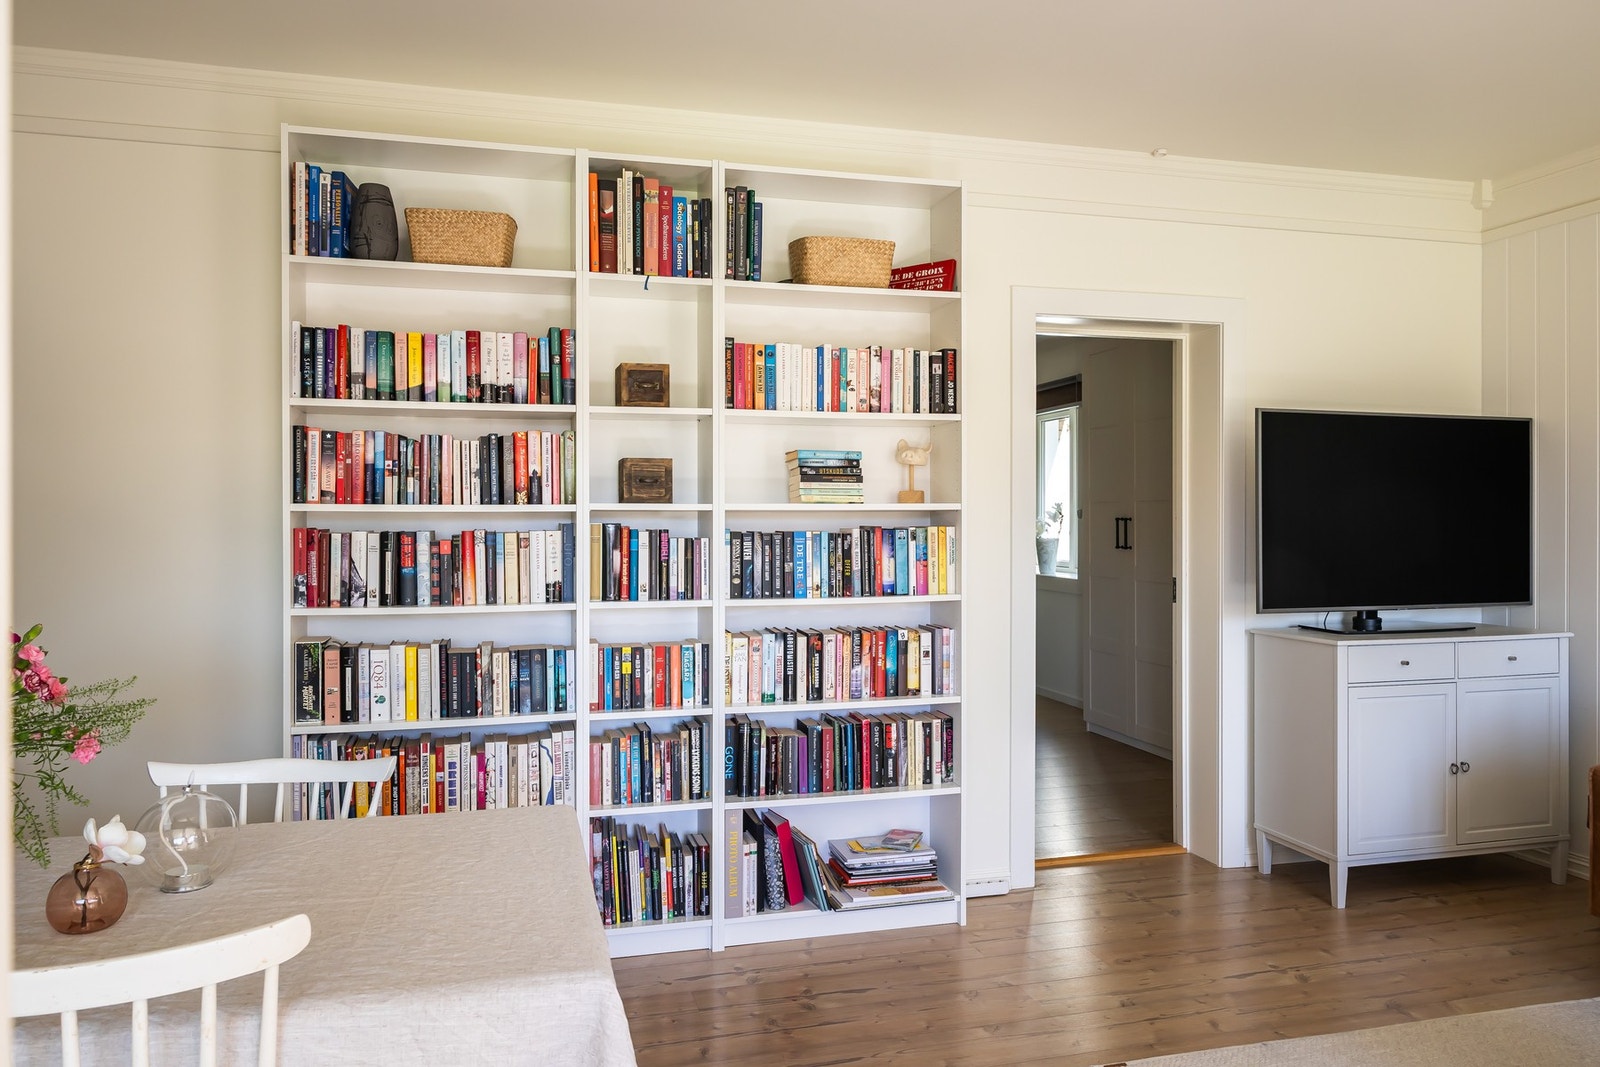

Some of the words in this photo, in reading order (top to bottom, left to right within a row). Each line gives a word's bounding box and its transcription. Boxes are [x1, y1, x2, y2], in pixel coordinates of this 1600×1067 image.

[890, 274, 901, 282] LE
[902, 271, 914, 280] DE
[915, 266, 944, 278] GROIX
[563, 336, 574, 363] Mykle
[744, 541, 752, 561] ULVEN
[796, 544, 804, 557] DE
[796, 559, 804, 580] TRE
[371, 660, 384, 689] 1Q84
[692, 749, 701, 775] LYKKENS
[725, 746, 734, 780] GONE
[728, 831, 739, 863] PHOTO
[728, 866, 739, 897] ALBUM
